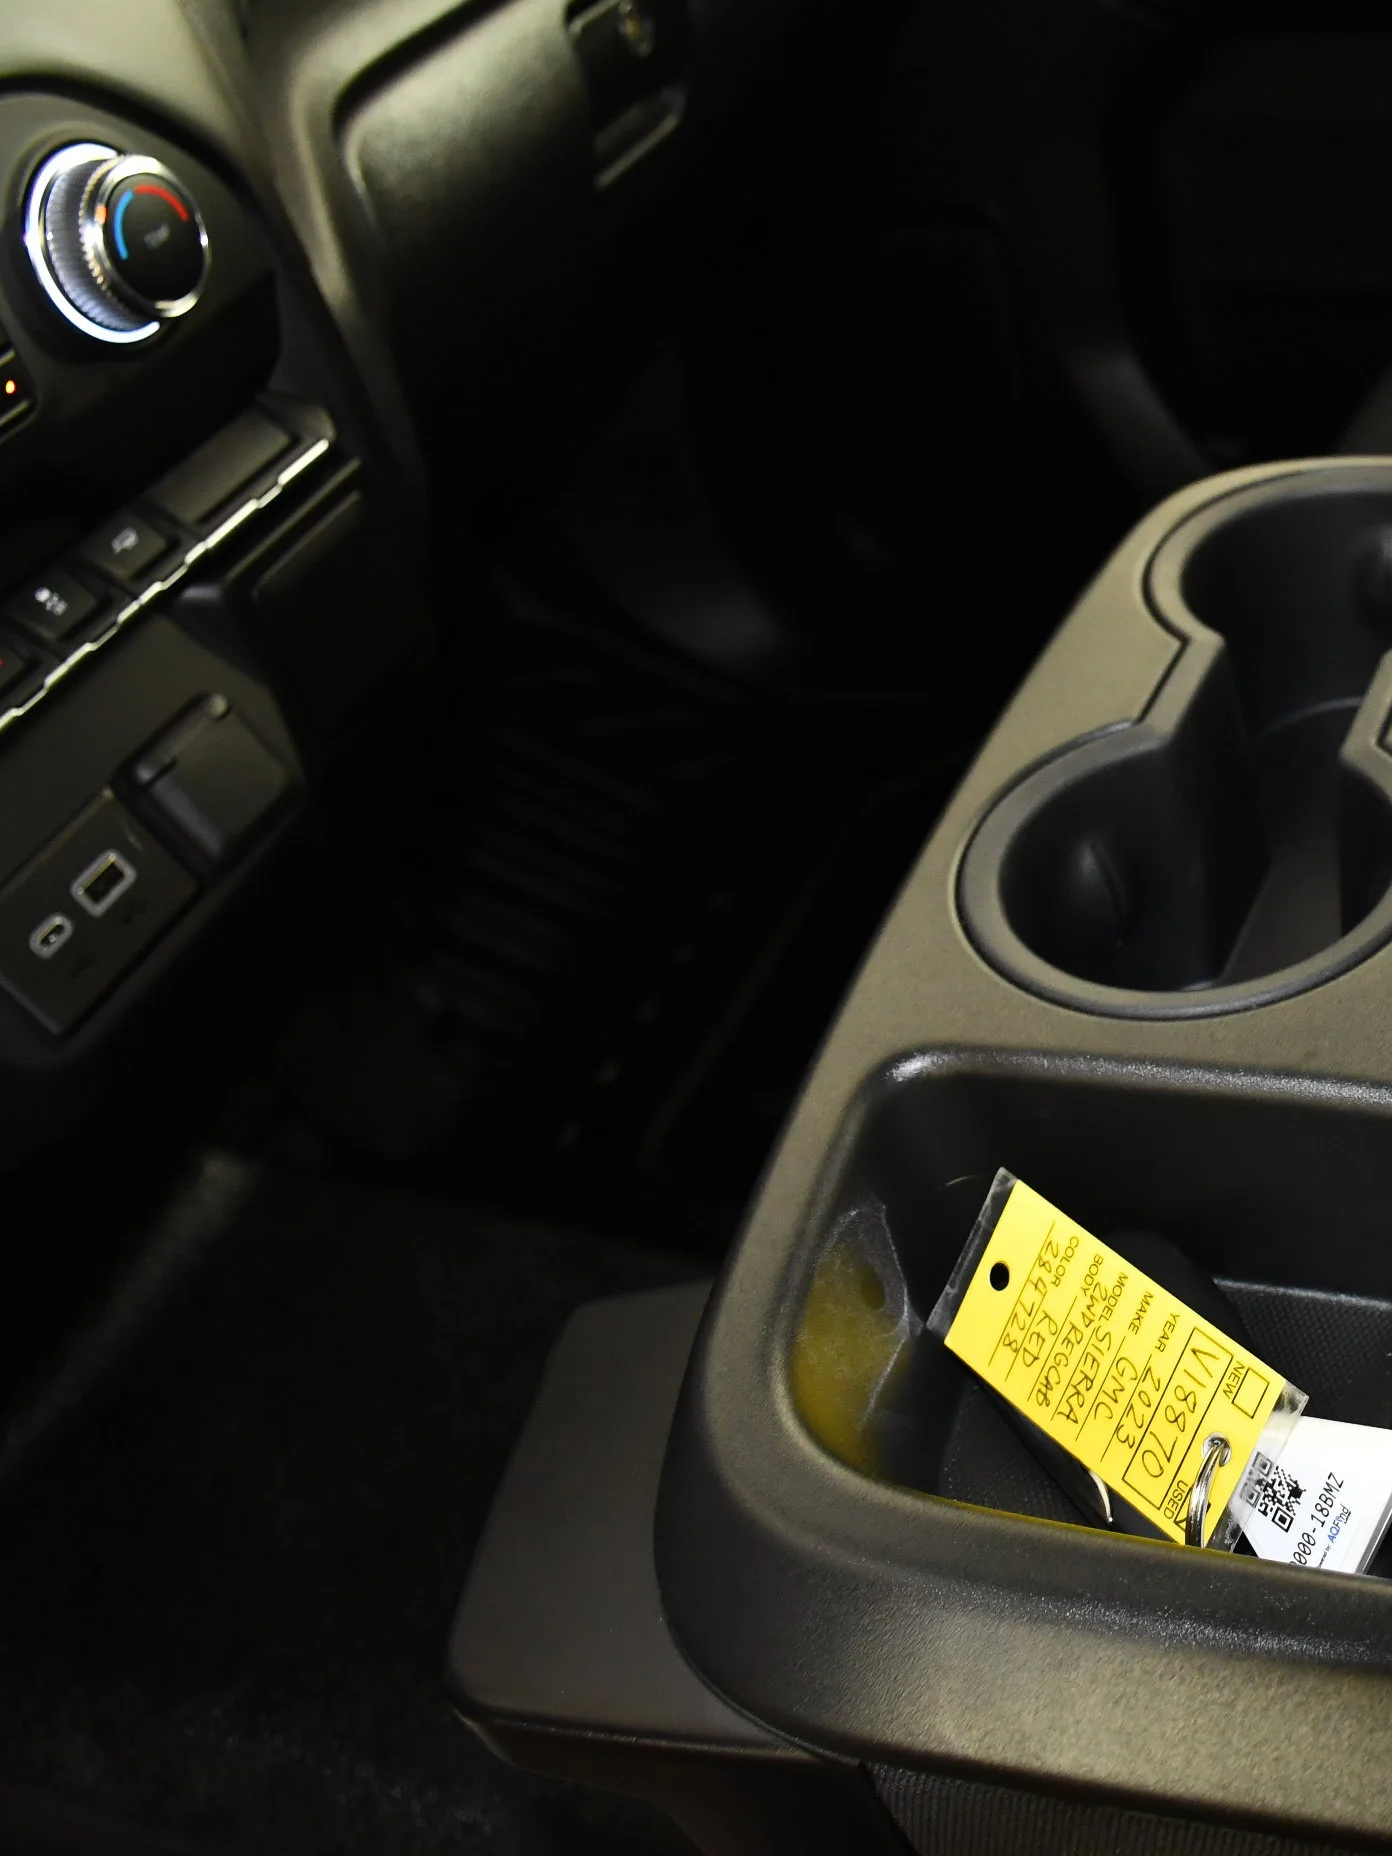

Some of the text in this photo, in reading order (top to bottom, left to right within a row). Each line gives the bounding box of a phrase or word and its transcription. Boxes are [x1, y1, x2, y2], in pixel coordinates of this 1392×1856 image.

[1050, 1236, 1079, 1287] COLOR
[1080, 1253, 1104, 1296] BODY
[1002, 1240, 1059, 1353] 284728
[1098, 1271, 1129, 1322] MODEL
[1127, 1290, 1154, 1335] MAKE
[1022, 1310, 1058, 1368] RED
[1154, 1312, 1181, 1353] YEAR
[1056, 1324, 1112, 1424] SIERRA
[1093, 1356, 1138, 1420] GMC
[1222, 1360, 1246, 1400] NEW
[1115, 1365, 1161, 1449] 2023
[1163, 1479, 1190, 1520] USED
